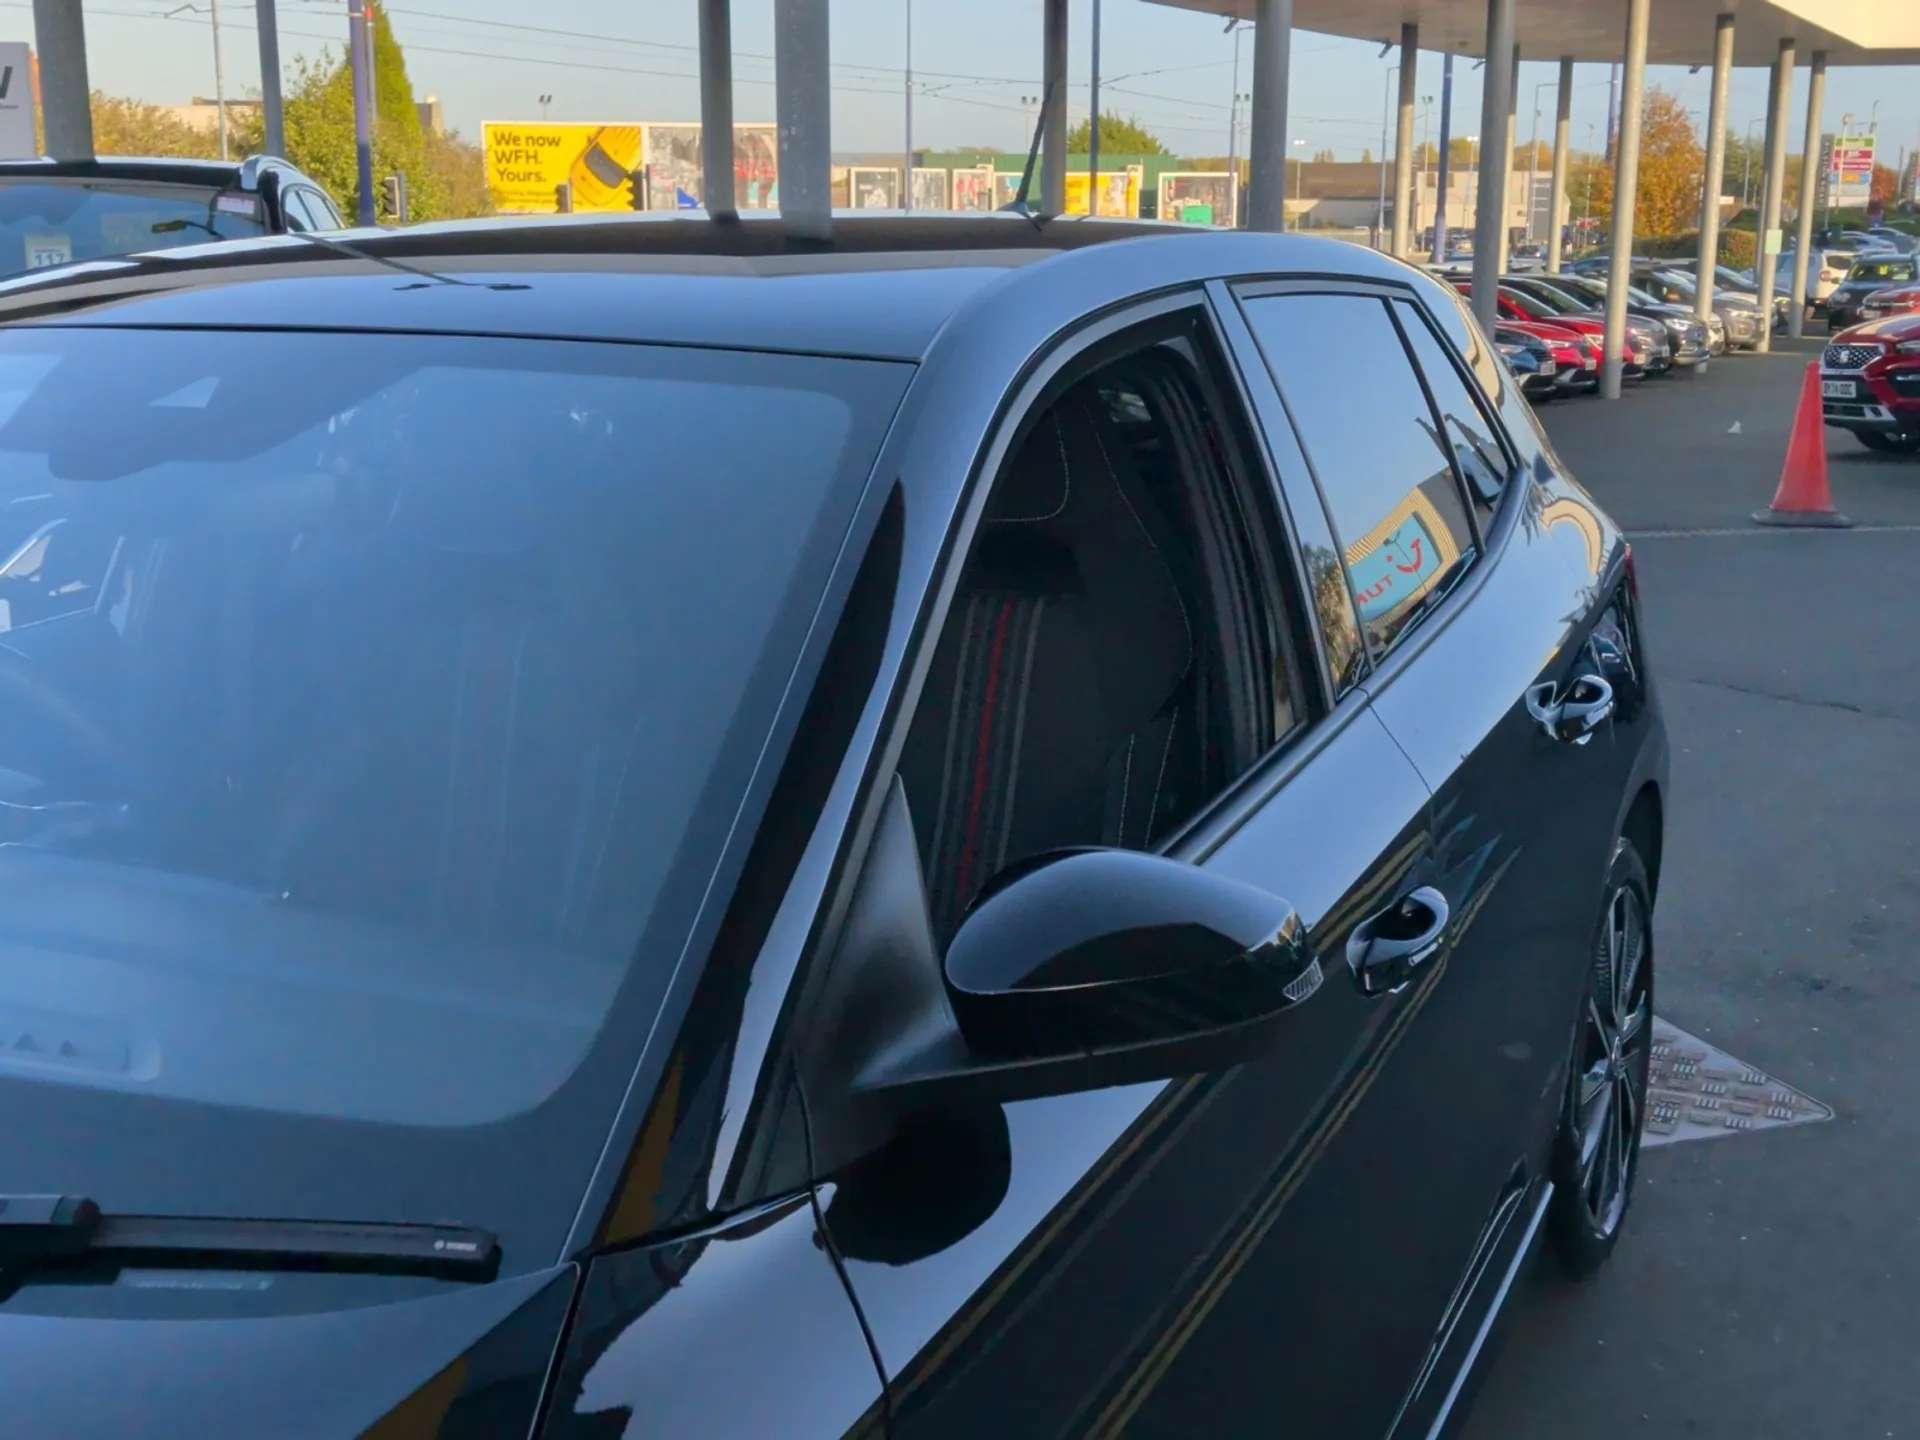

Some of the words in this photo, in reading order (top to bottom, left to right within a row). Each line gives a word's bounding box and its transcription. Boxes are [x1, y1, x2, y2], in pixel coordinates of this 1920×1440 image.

[493, 131, 521, 147] We
[525, 135, 561, 147] now
[494, 149, 544, 165] WFH.
[496, 167, 547, 183] Yours.
